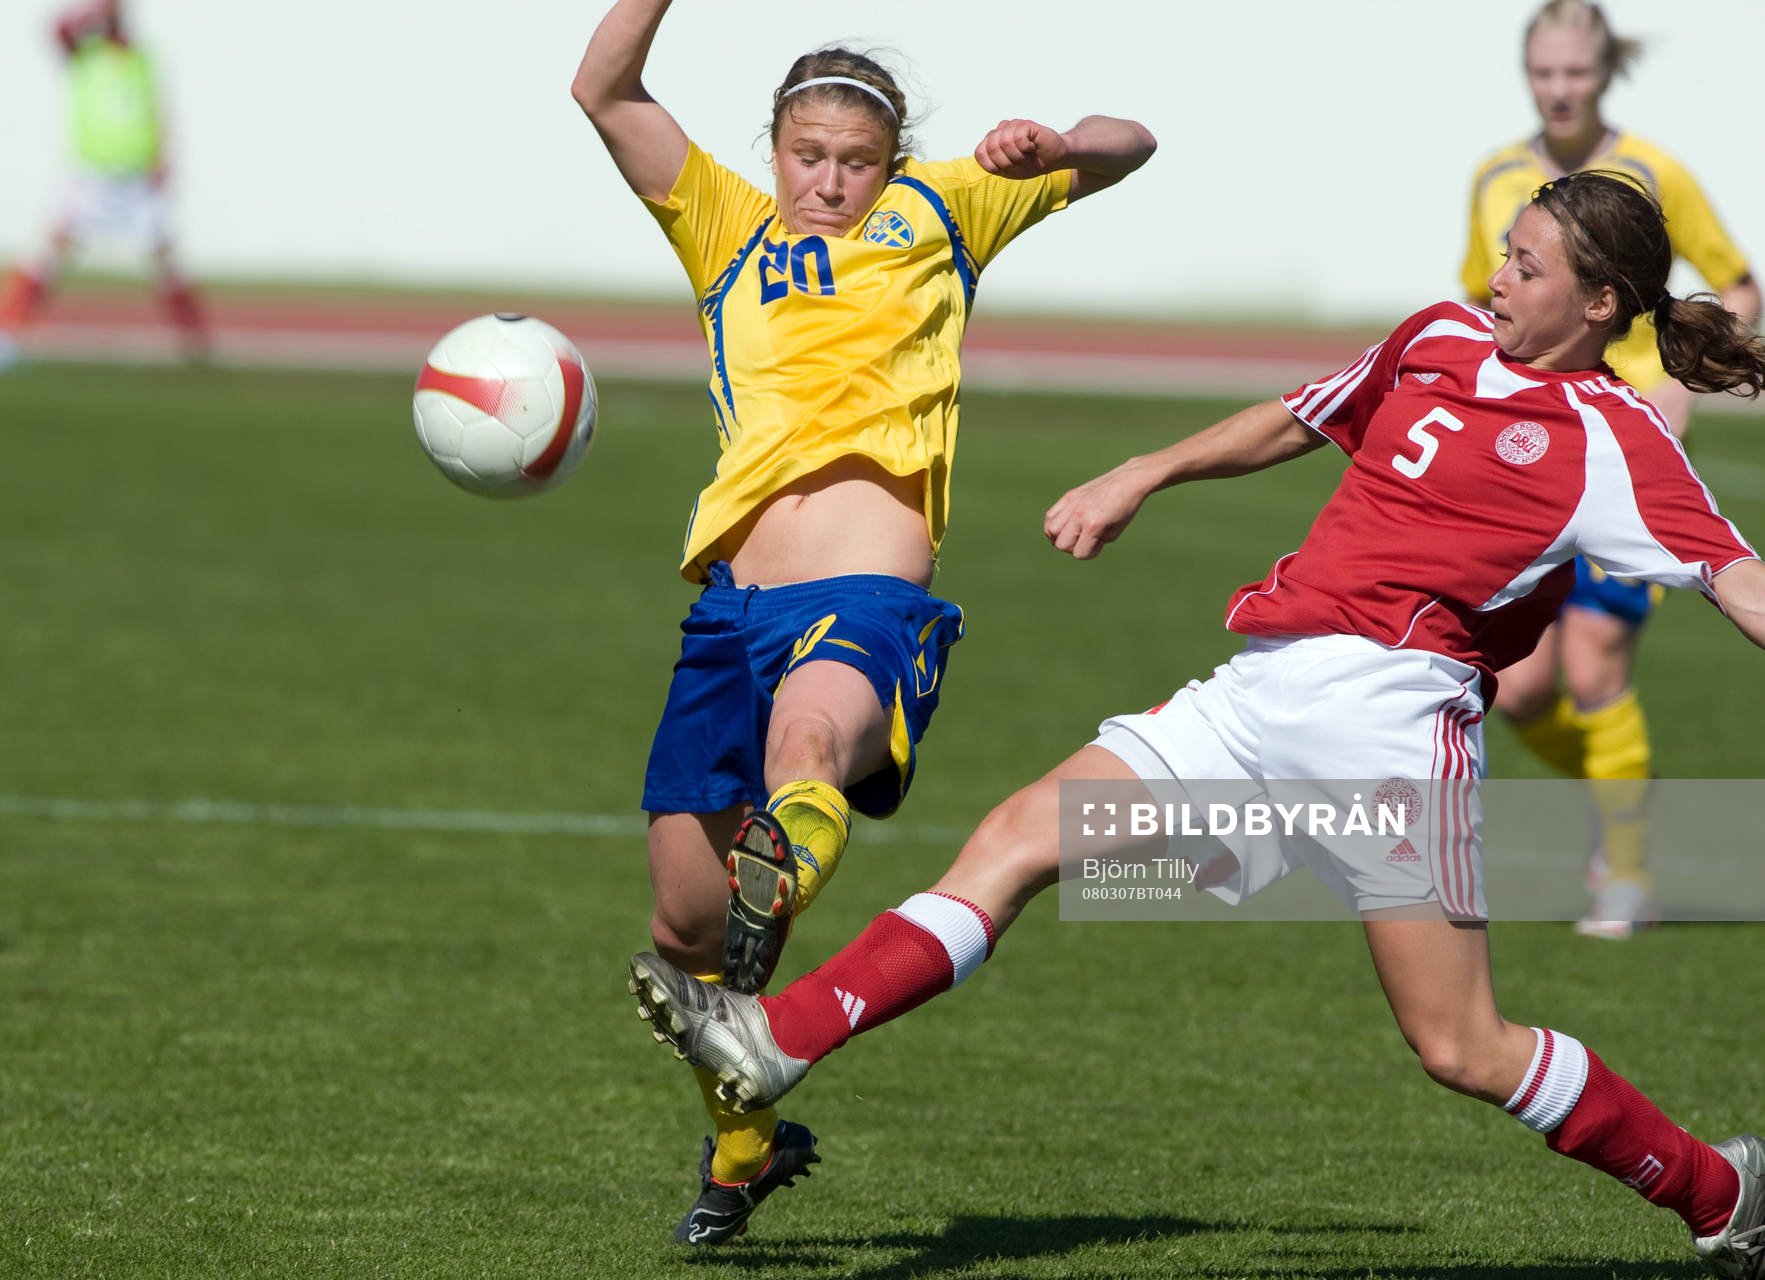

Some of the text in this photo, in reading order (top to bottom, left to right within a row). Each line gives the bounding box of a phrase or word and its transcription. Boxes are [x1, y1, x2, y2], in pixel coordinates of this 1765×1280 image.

[758, 235, 836, 305] 20
[1392, 406, 1465, 479] 5
[1509, 432, 1537, 454] DBU
[1386, 854, 1422, 862] adidas
